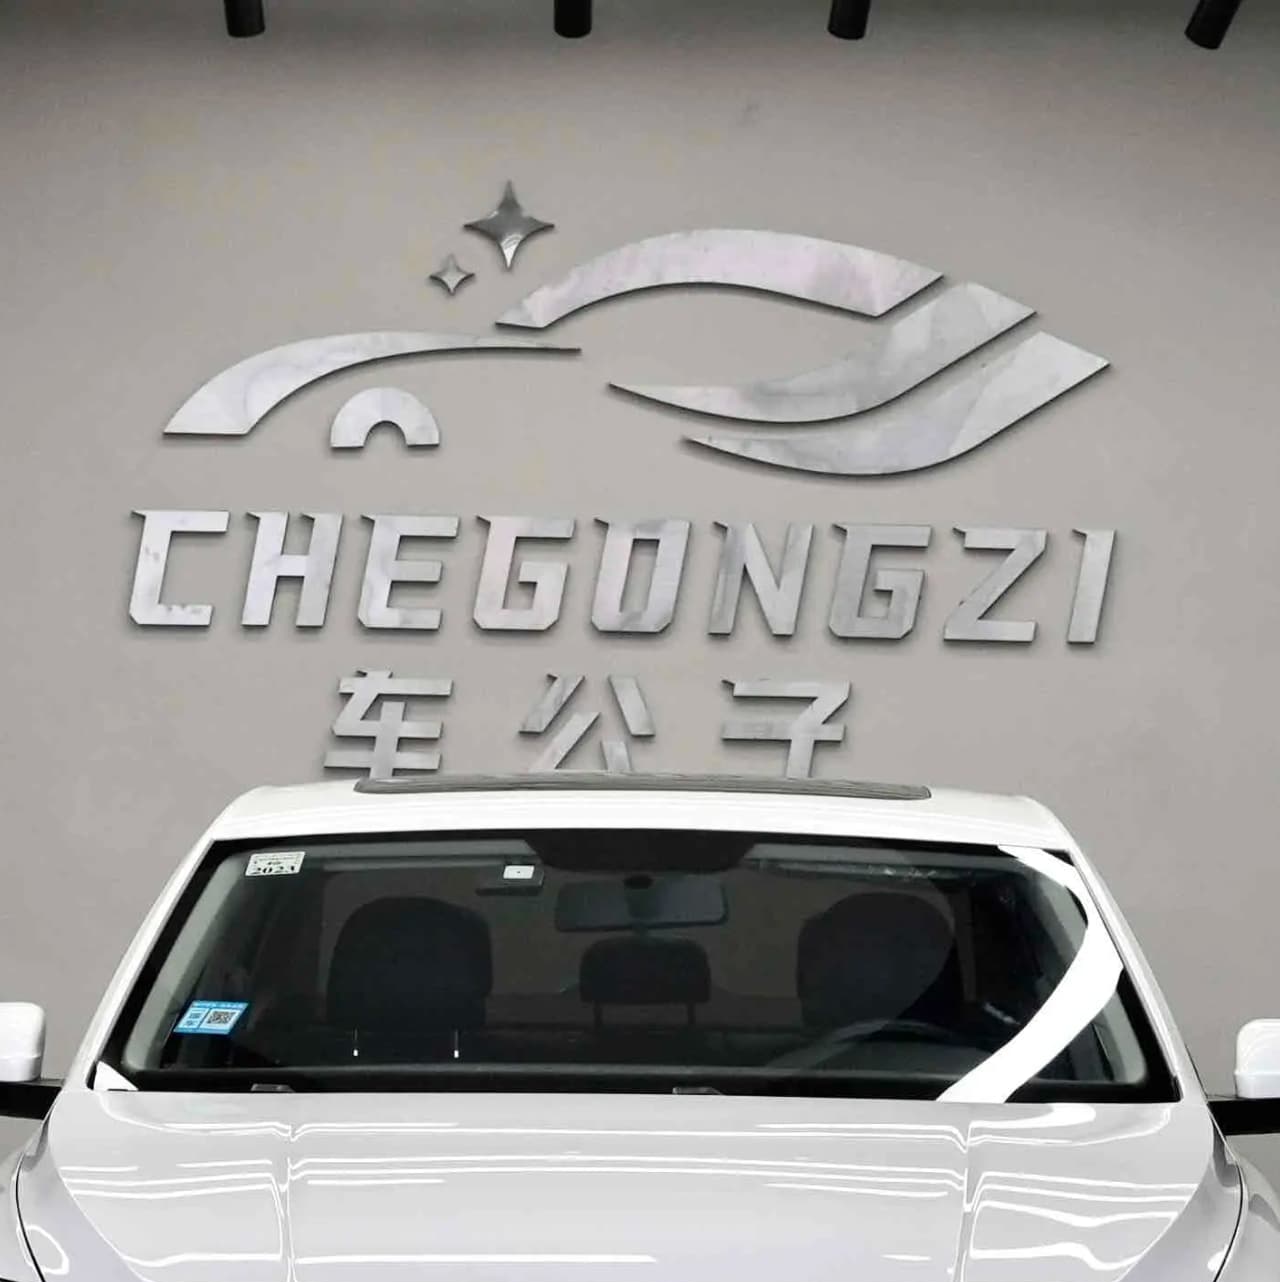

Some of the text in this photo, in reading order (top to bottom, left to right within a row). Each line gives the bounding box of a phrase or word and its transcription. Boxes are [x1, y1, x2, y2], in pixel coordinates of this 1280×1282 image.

[128, 509, 1117, 645] CHEGONGZI
[324, 670, 851, 778] 车公子
